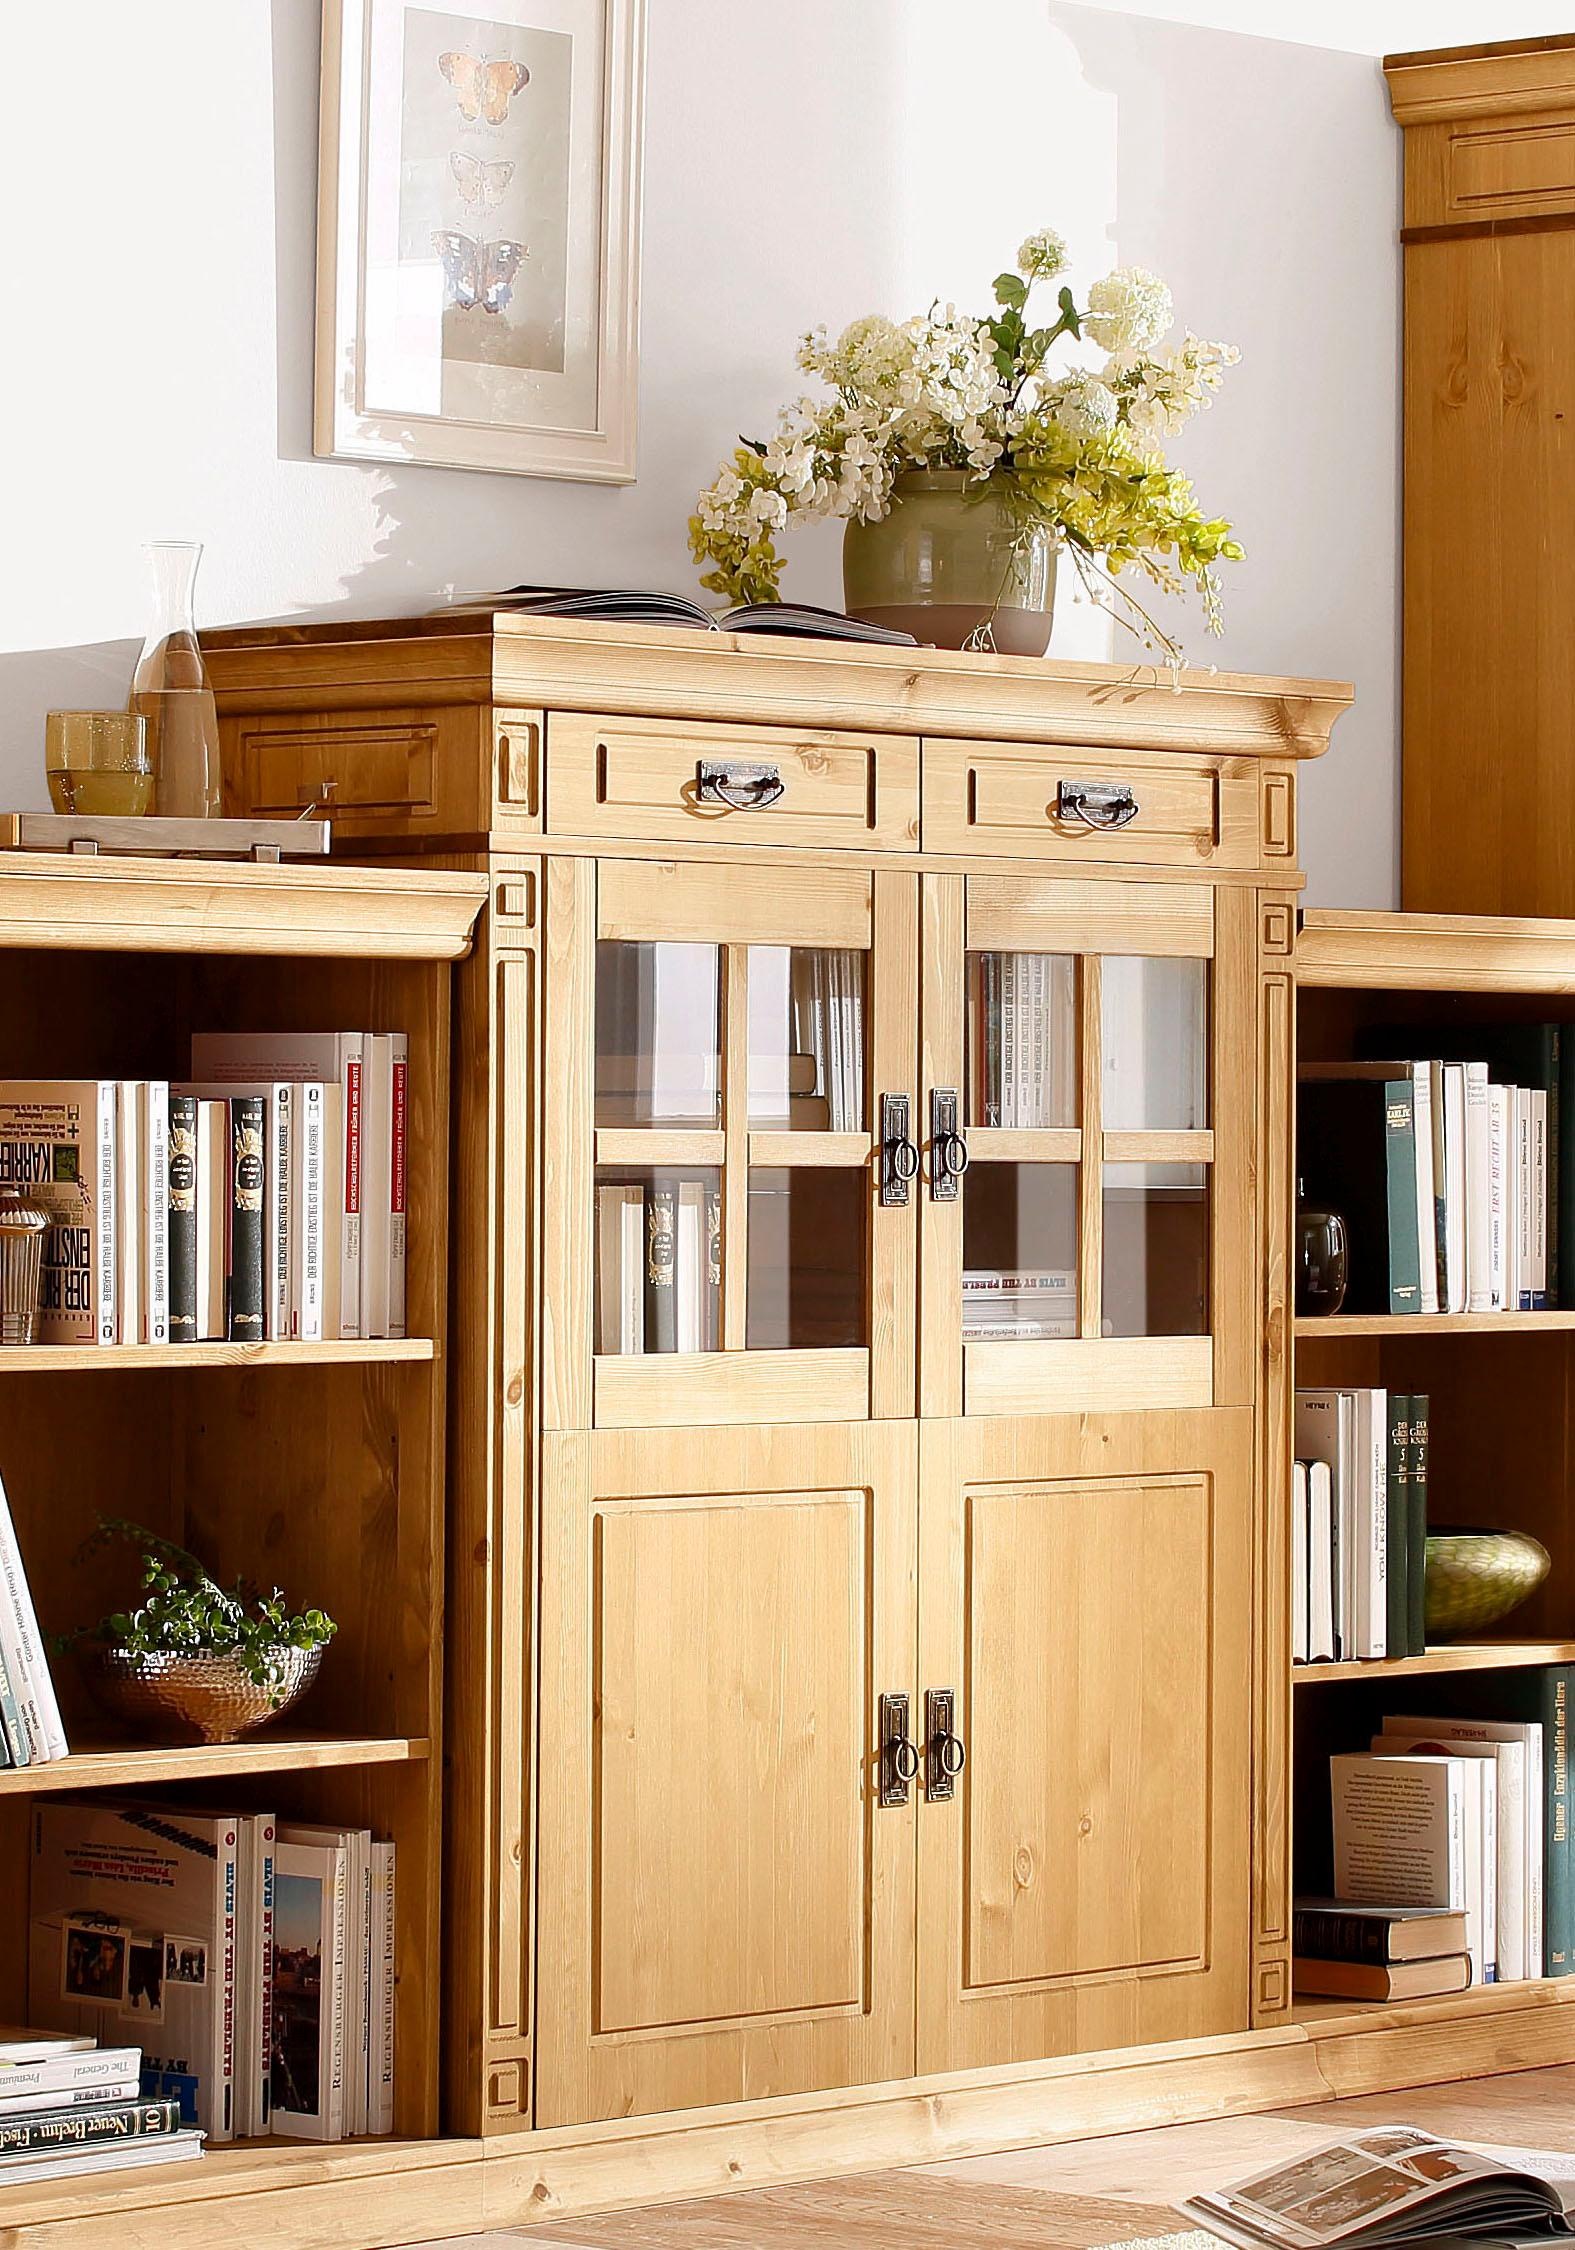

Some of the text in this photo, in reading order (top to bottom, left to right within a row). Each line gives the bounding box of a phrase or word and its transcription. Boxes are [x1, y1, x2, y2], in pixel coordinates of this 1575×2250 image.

[102, 1144, 112, 1157] DER
[154, 1144, 164, 1157] DER
[279, 1193, 288, 1204] IST
[308, 1193, 318, 1203] IST
[102, 1221, 112, 1232] IST
[154, 1221, 164, 1232] IST
[279, 1205, 288, 1234] EINSTIEG
[308, 1205, 318, 1234] EINSTIEG
[279, 1236, 288, 1265] RICHTIGE
[308, 1235, 318, 1264] RICHTIGE
[279, 1266, 288, 1280] DER
[308, 1266, 318, 1278] DER
[65, 1270, 91, 1311] DER
[1002, 1279, 1021, 1289] THE
[1024, 1278, 1037, 1288] BY
[1400, 1448, 1406, 1461] 5
[1418, 1448, 1424, 1460] 5
[21, 1629, 33, 1662] Günter
[1554, 1681, 1565, 1707] Tiere
[1555, 1709, 1565, 1727] der
[224, 1862, 234, 2077] ELVIS BY THE PRESLEYS
[262, 1857, 272, 2071] ELVIS BY THE PRESLEYS
[73, 2062, 129, 2078] The General
[40, 2119, 86, 2142] Brehm
[87, 2114, 128, 2134] Neuer
